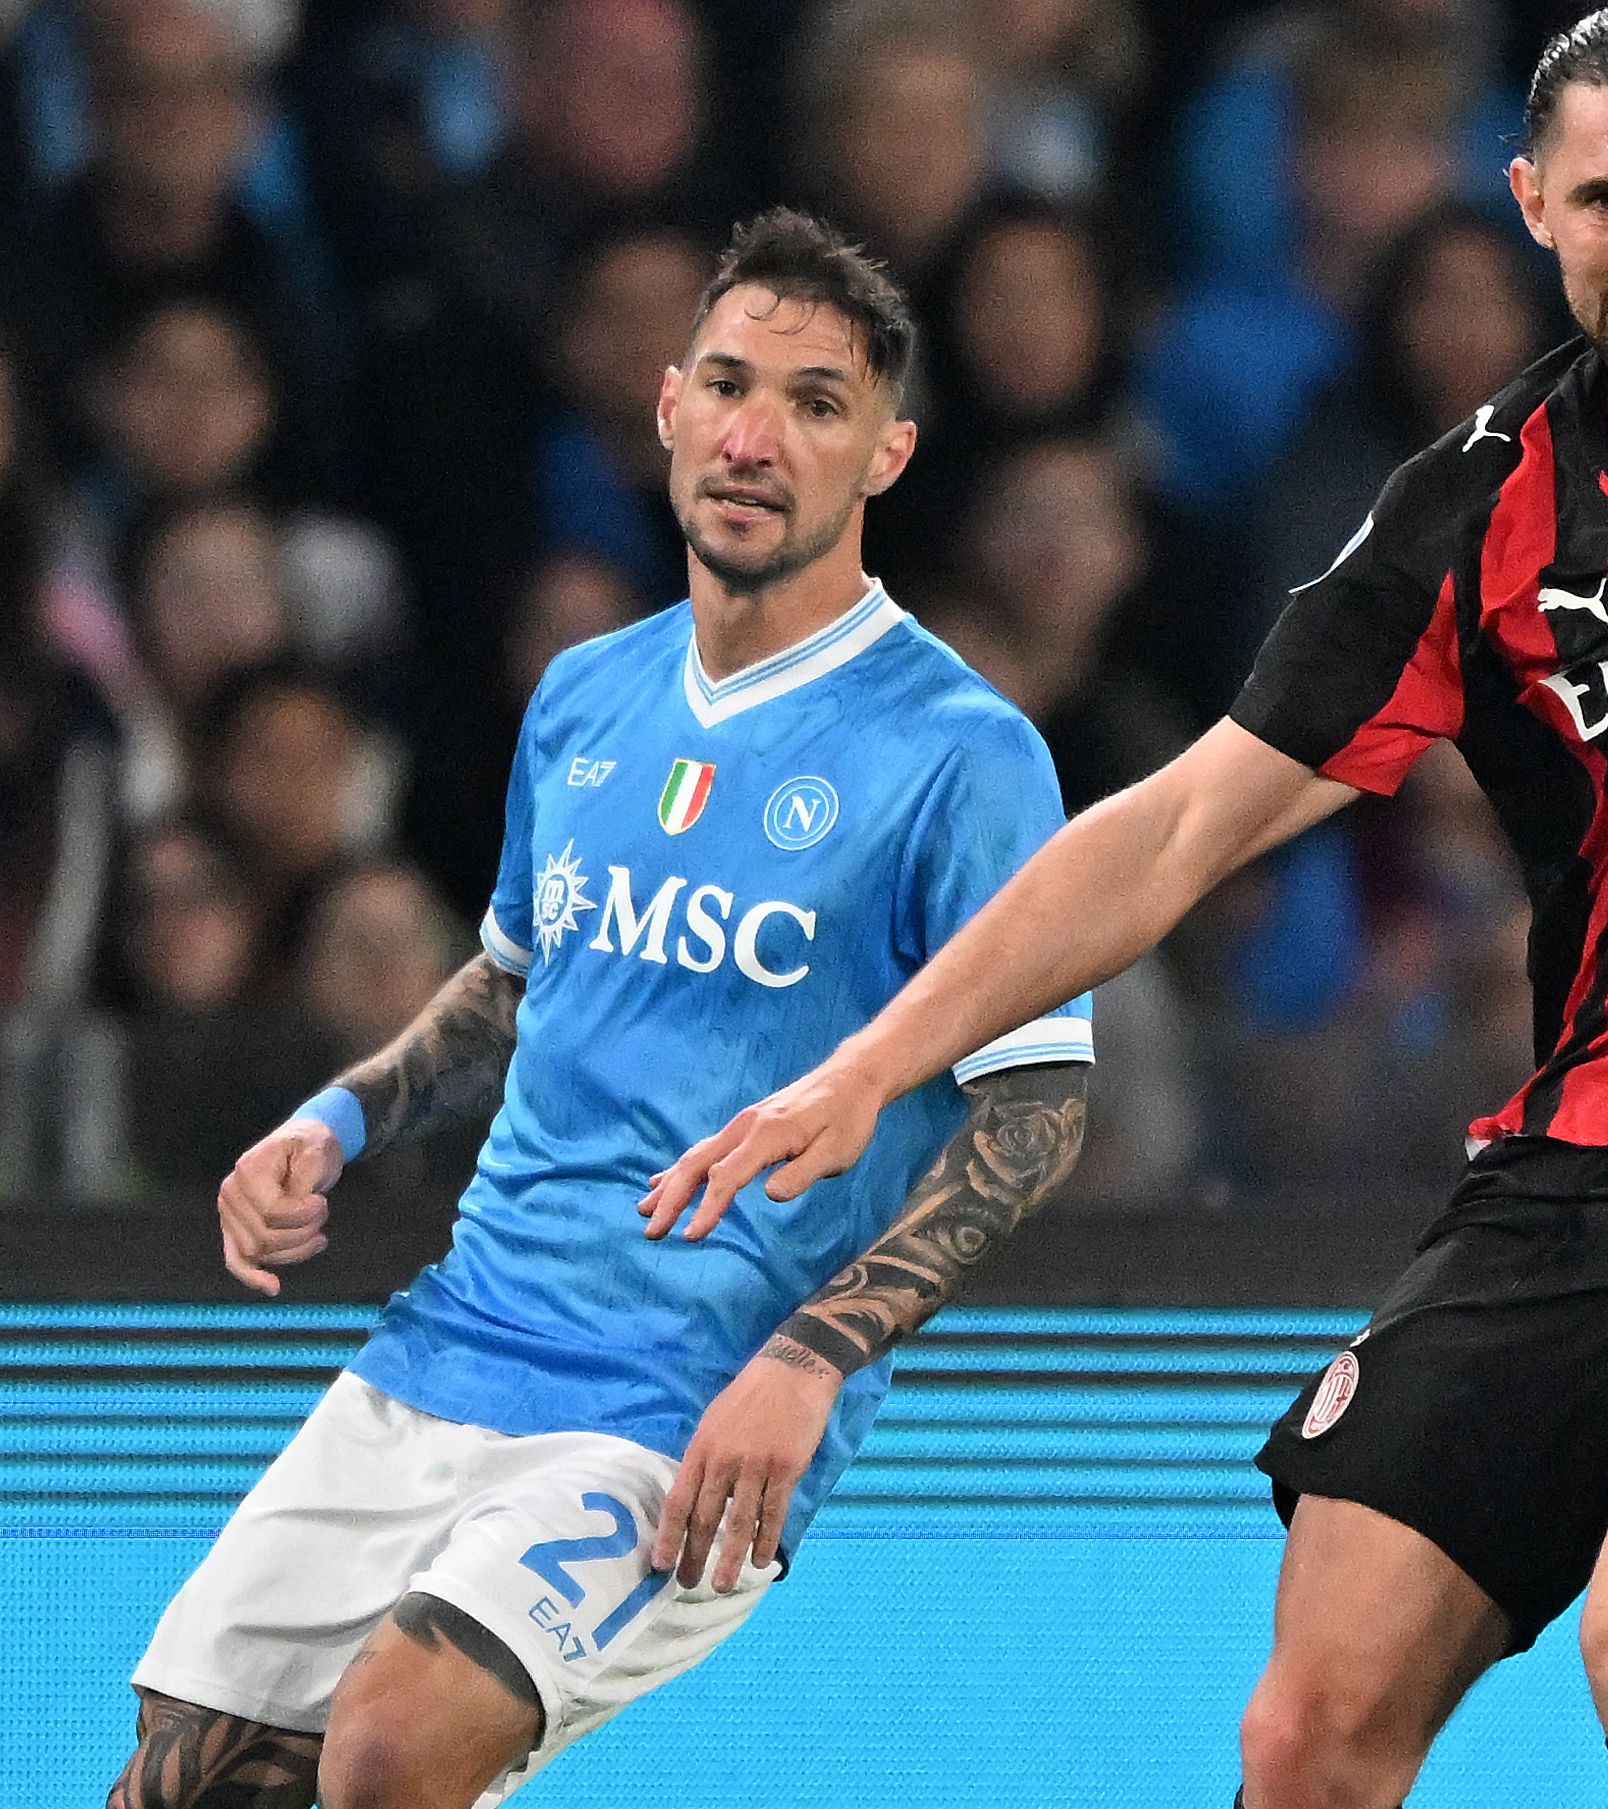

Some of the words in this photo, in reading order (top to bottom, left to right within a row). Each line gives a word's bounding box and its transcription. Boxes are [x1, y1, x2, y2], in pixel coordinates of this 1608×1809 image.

[567, 757, 617, 788] EA7
[783, 795, 822, 832] N
[589, 866, 816, 987] MSC
[518, 1491, 675, 1652] 21
[528, 1597, 587, 1662] EA7
